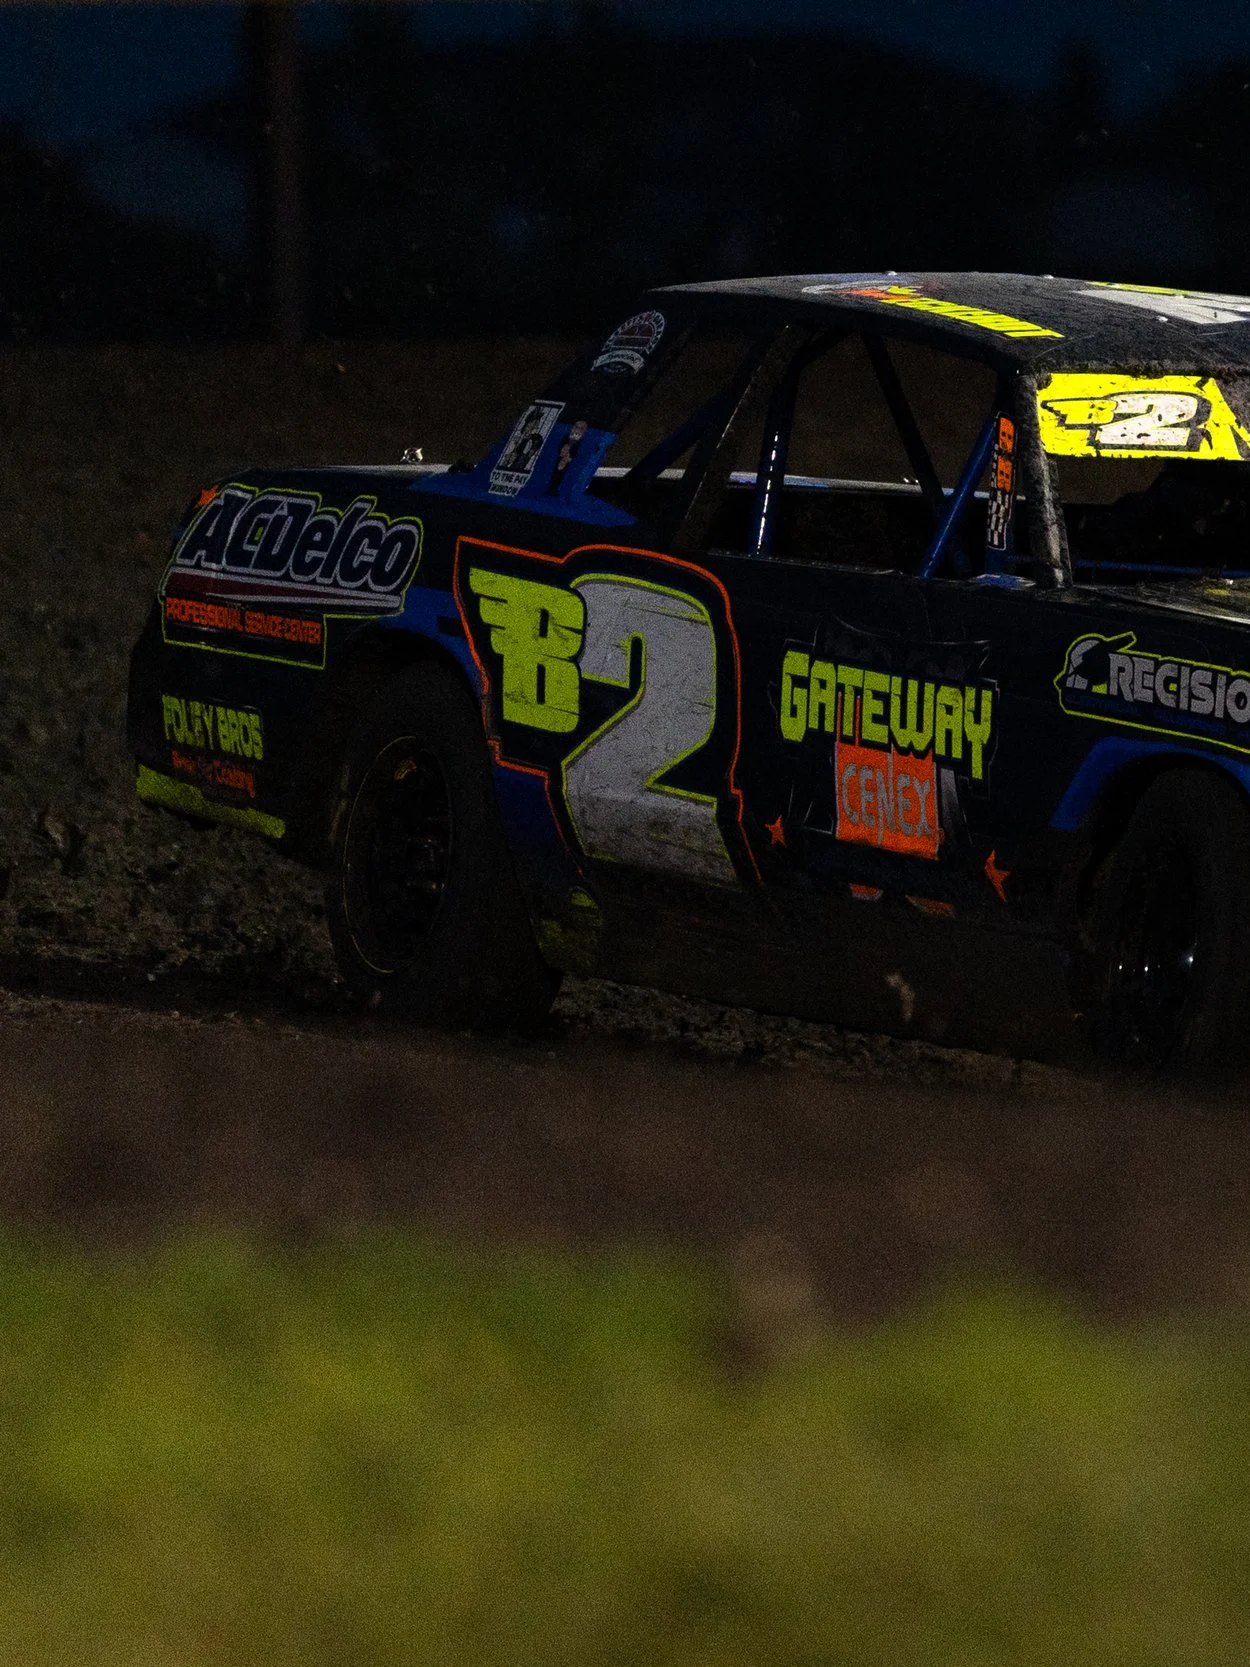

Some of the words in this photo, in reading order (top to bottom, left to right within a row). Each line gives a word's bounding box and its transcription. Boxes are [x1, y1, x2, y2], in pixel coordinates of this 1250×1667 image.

[174, 488, 420, 593] ACDelco
[215, 705, 264, 761] BROS
[780, 650, 993, 780] GATEWAY
[841, 763, 932, 838] CENEX
